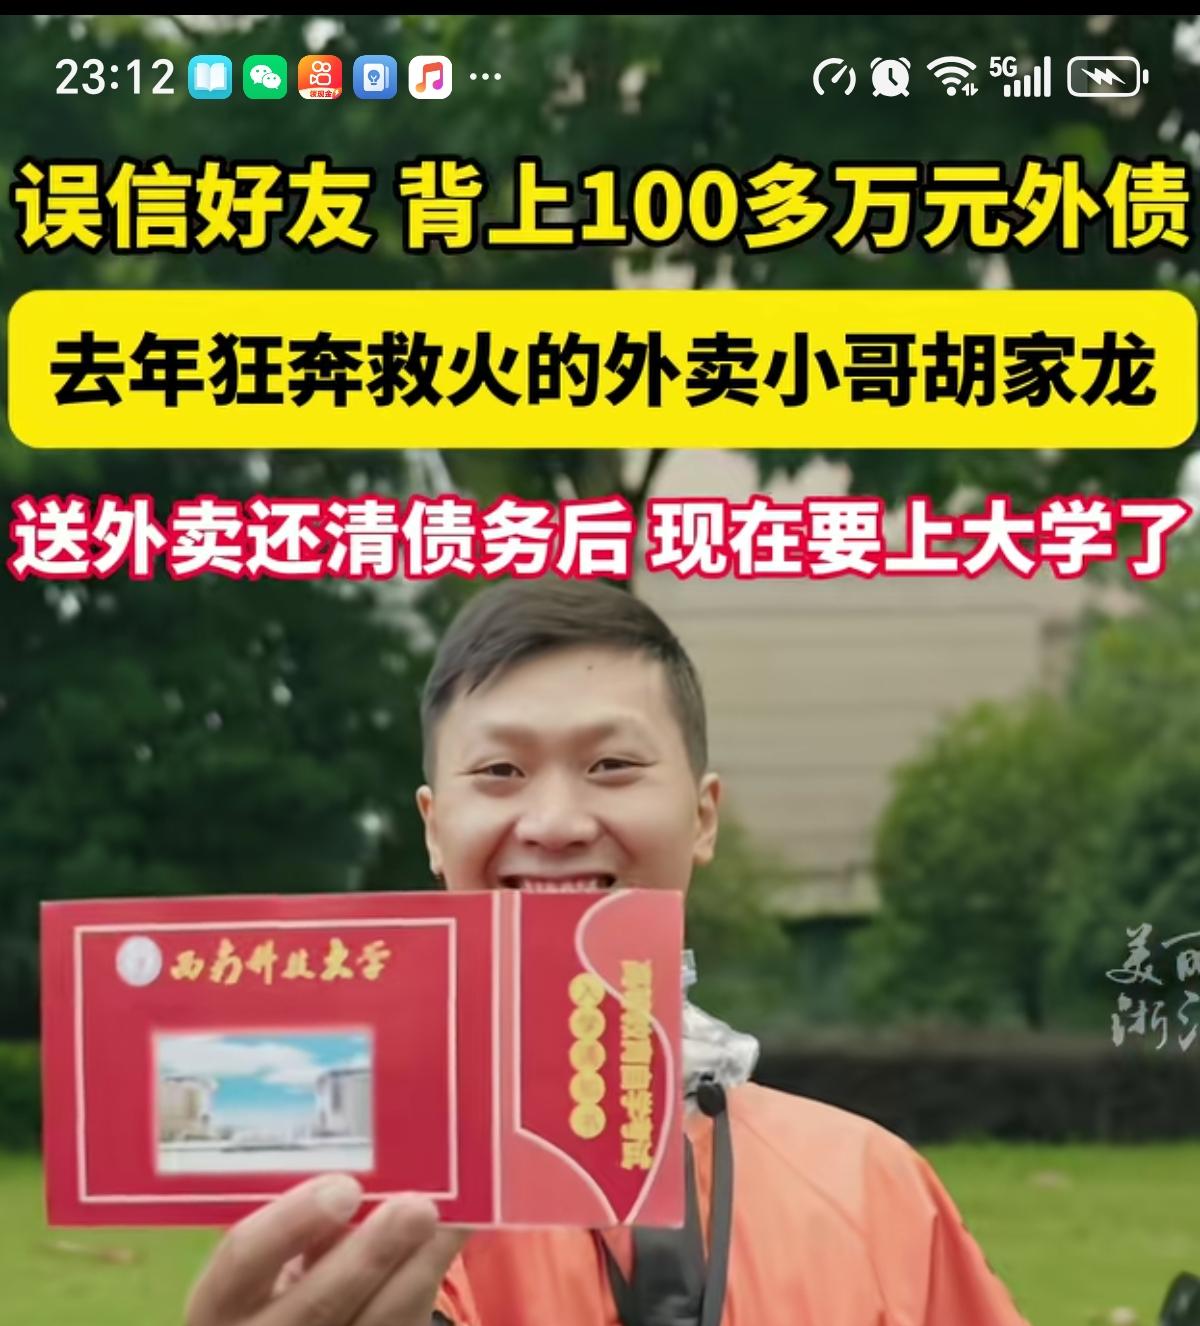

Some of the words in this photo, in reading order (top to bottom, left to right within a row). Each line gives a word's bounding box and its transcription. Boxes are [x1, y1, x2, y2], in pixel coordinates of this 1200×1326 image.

[170, 937, 391, 985] 西南科技大学
